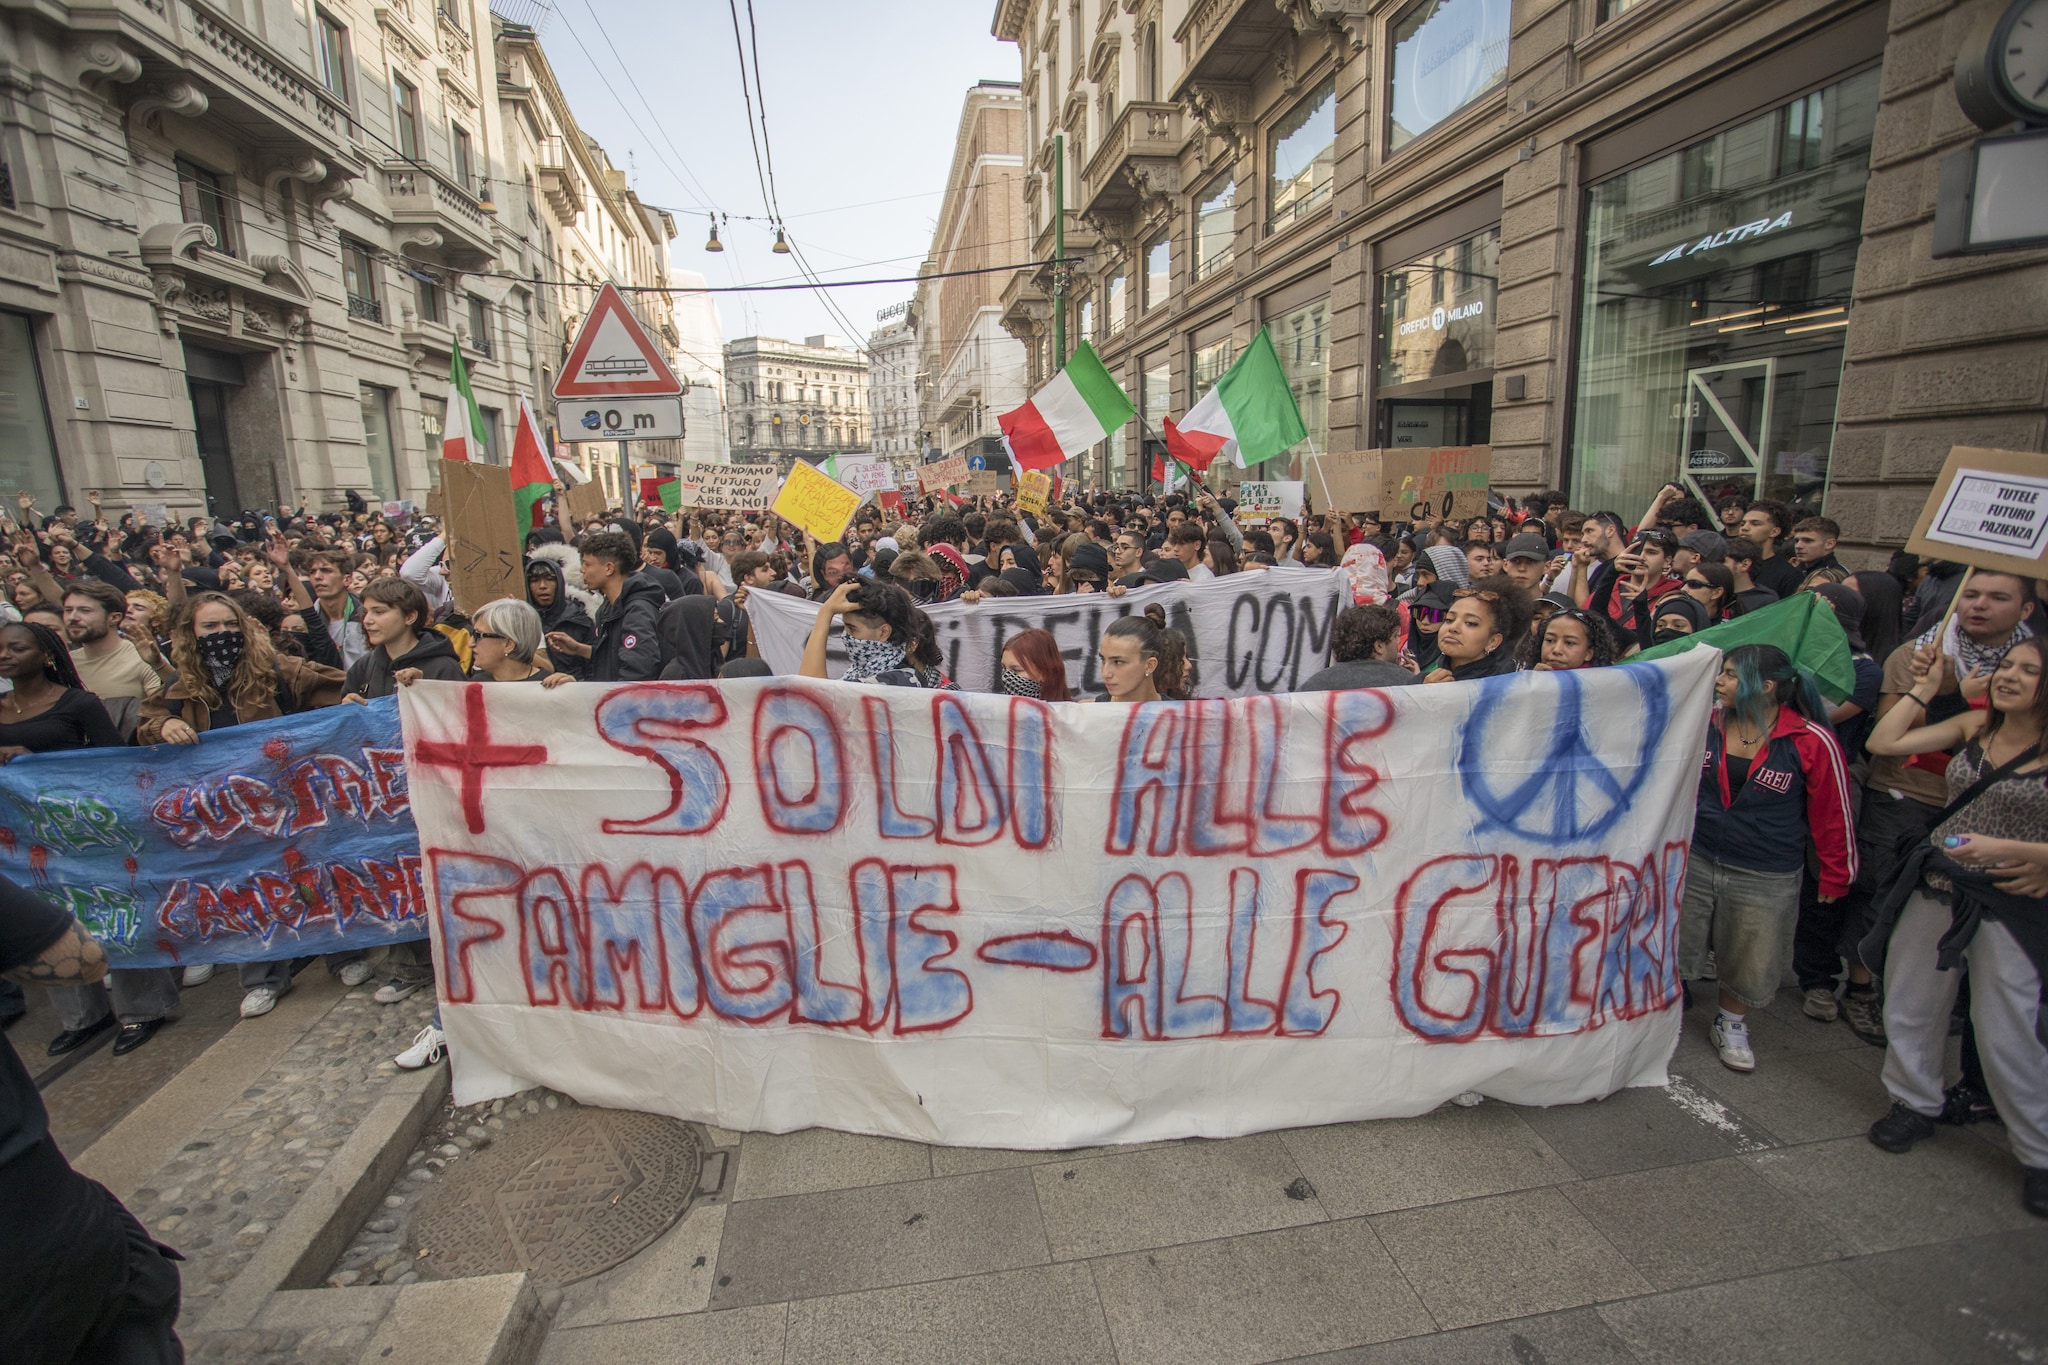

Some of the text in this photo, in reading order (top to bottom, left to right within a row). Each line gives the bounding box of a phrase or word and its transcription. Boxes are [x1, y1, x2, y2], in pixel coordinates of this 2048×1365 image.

[1686, 211, 1792, 255] ALTRA
[877, 301, 905, 322] GUCCI
[1400, 316, 1430, 335] OREFICI
[1447, 301, 1483, 322] MILANO
[634, 413, 655, 428] m
[695, 463, 773, 476] PRETENDIAMO
[1690, 456, 1726, 465] ASTPAK
[687, 475, 761, 487] UN FUTURO
[700, 486, 723, 495] CHE
[731, 488, 758, 497] NON
[1964, 480, 2039, 504] ZERO TUTELE
[1954, 499, 2036, 522] ZERO FUTURO
[1944, 517, 2034, 540] ZERO PAZIENZA
[597, 683, 1055, 851] SOLDI
[1106, 687, 1396, 858] ALLE
[428, 846, 975, 1036] FAMIGLIE
[1102, 867, 1360, 1041] ALLE
